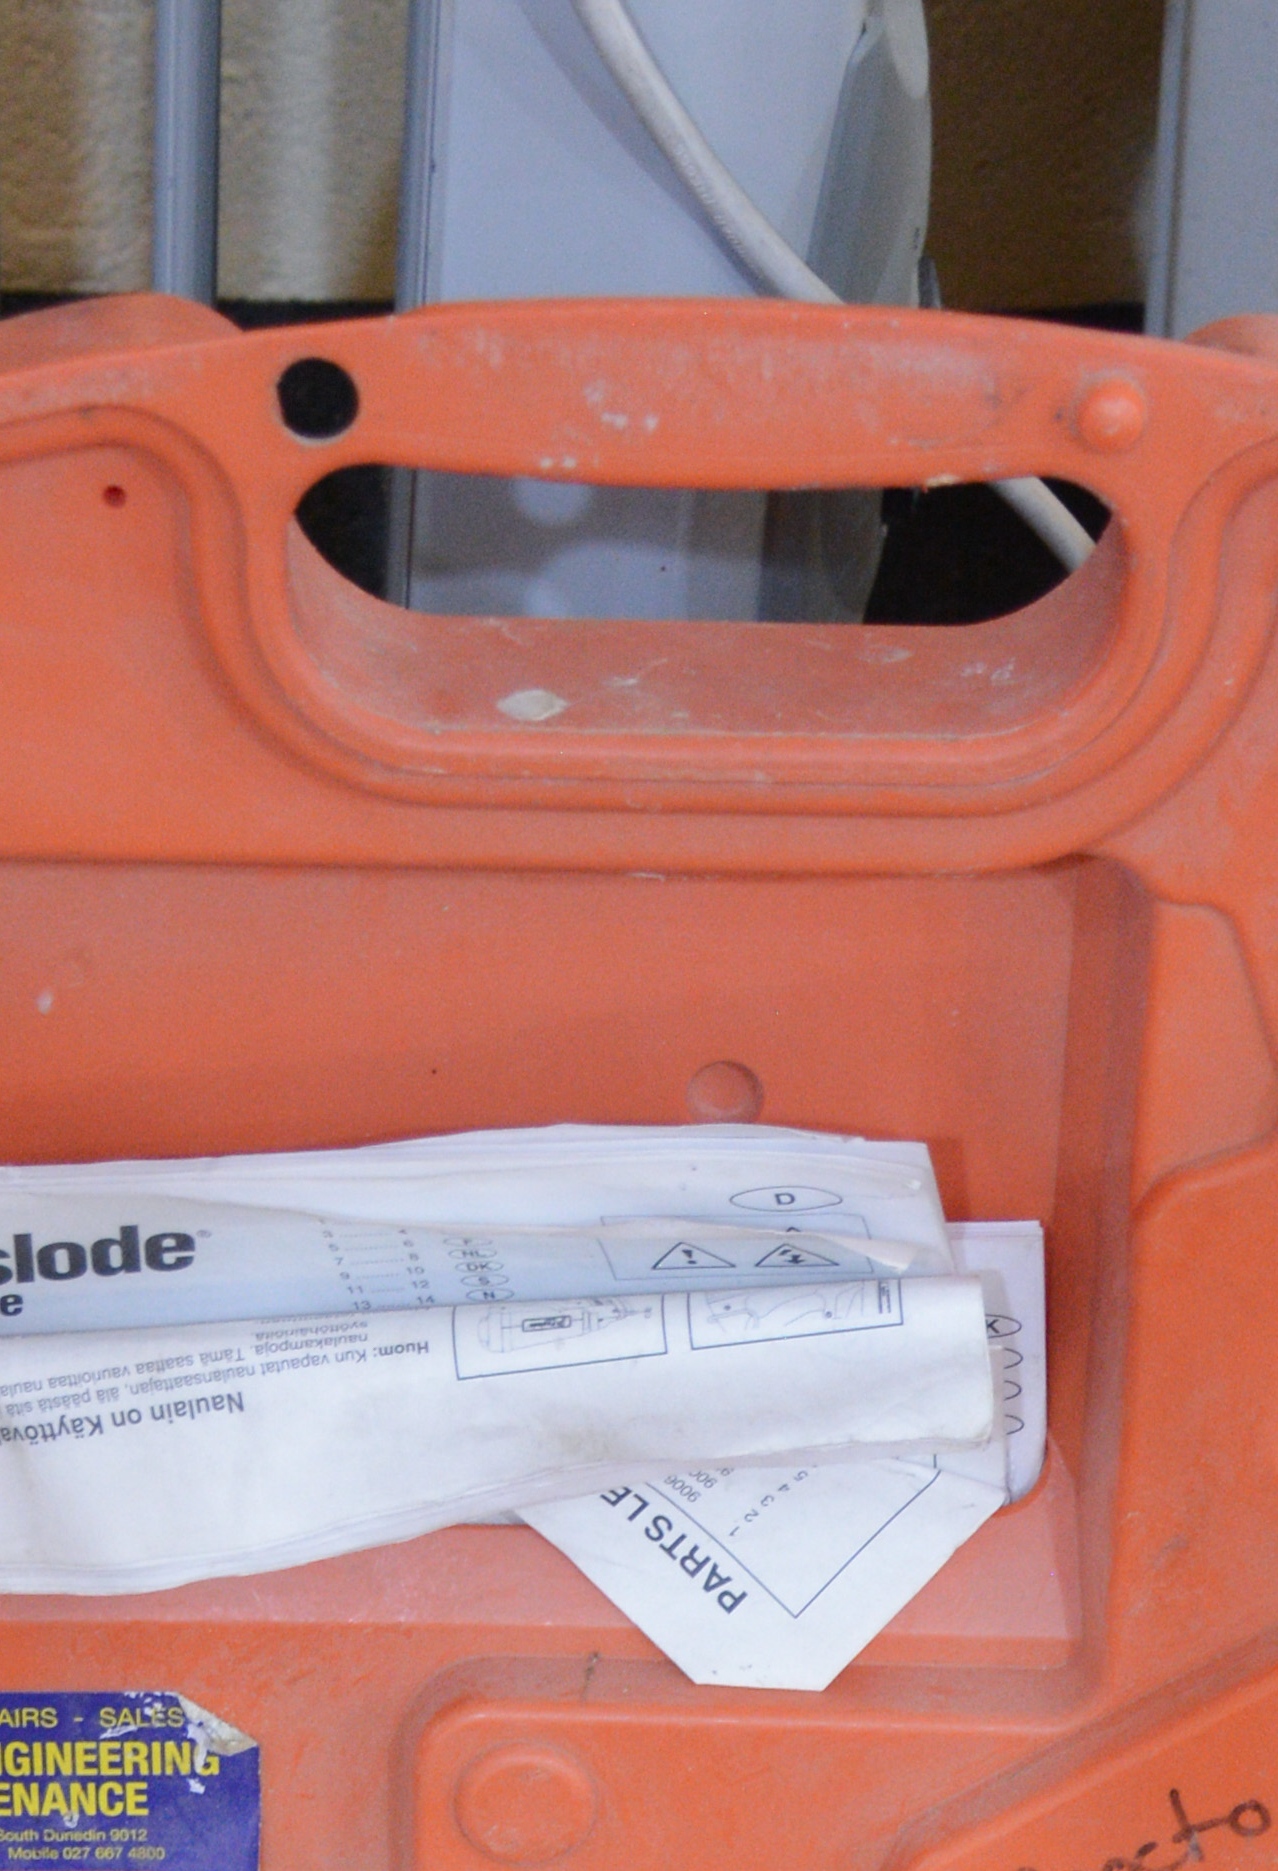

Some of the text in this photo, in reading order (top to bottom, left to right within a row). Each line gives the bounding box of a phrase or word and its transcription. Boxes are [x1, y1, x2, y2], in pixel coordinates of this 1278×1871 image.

[775, 1193, 795, 1205] D
[353, 1301, 371, 1310] 13
[336, 1349, 367, 1364] Kun
[373, 1341, 429, 1358] Huom:
[151, 1392, 244, 1423] Naulain
[112, 1408, 142, 1428] on
[644, 1515, 748, 1614] PARTS
[99, 1707, 185, 1728] SALES
[44, 1829, 106, 1841] Dunedin
[110, 1829, 147, 1841] 9012
[8, 1848, 58, 1860] Mobile
[63, 1848, 90, 1859] 027
